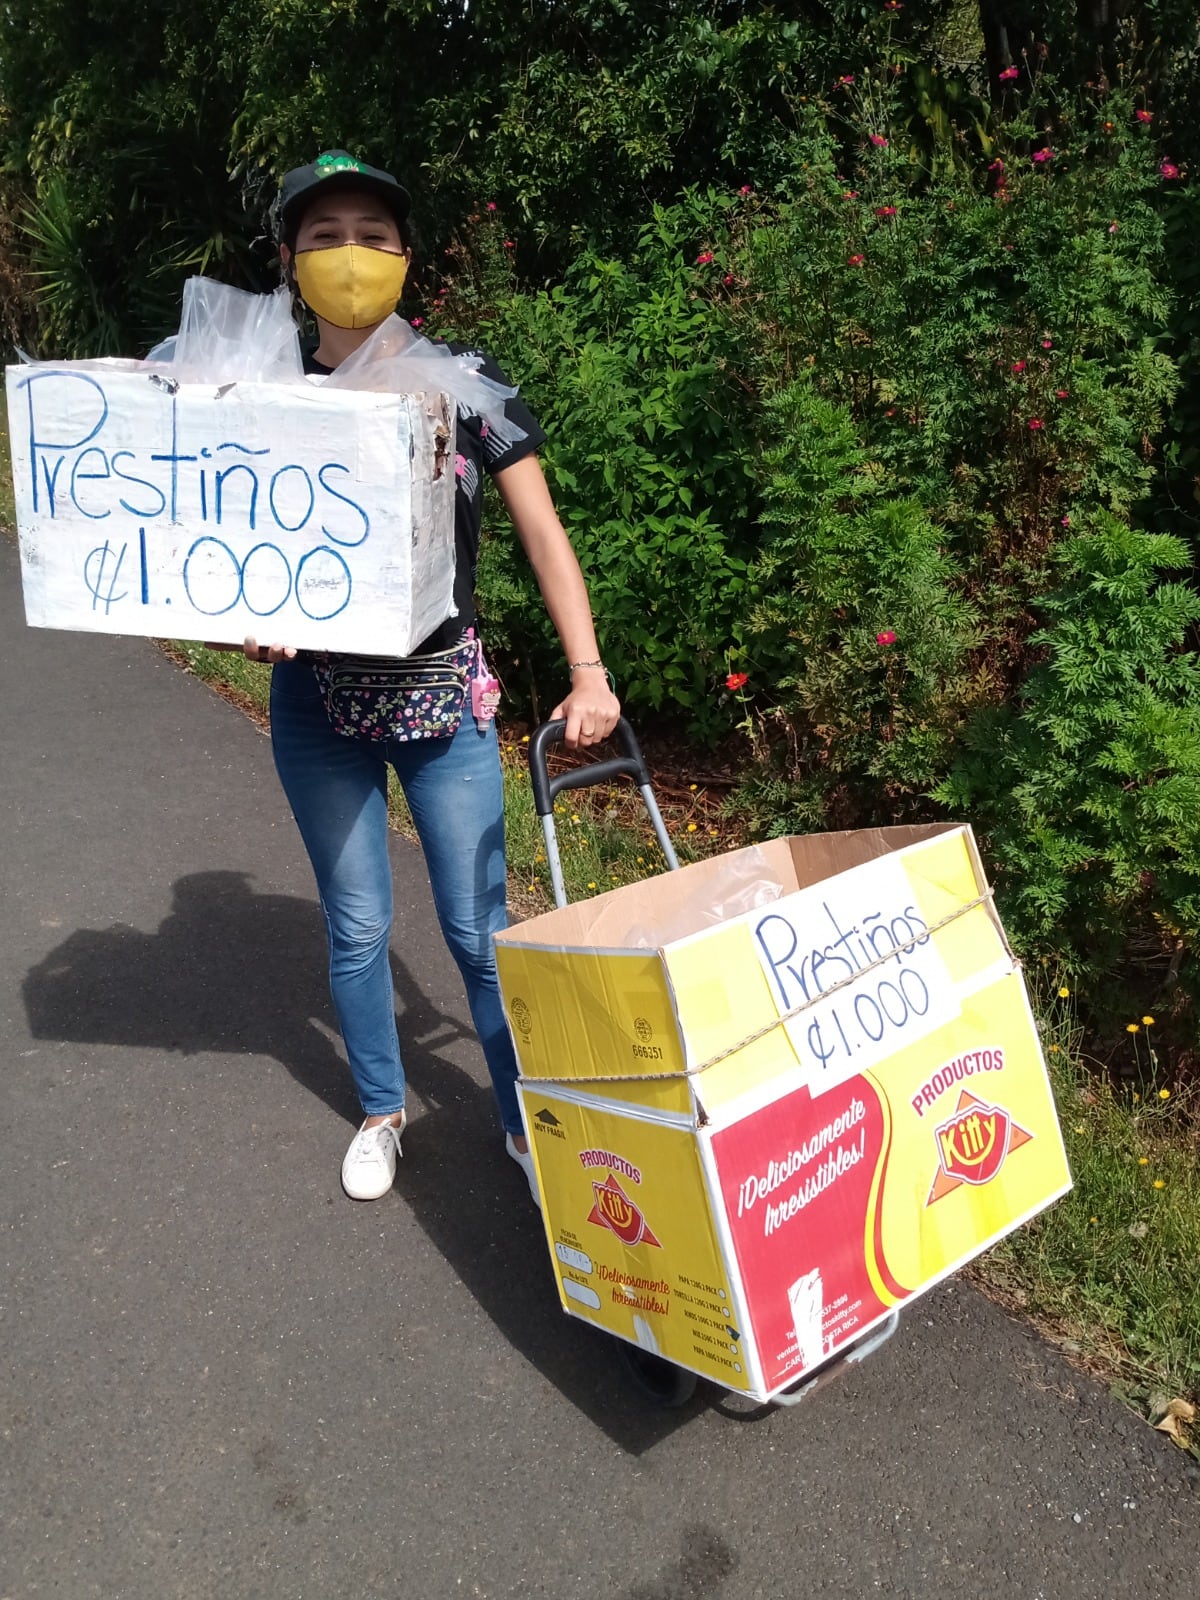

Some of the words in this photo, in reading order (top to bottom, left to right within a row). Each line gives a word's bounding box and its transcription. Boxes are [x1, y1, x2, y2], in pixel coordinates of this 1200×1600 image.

[17, 371, 370, 547] Prestiños
[632, 1044, 663, 1060] 666351
[911, 1049, 1003, 1117] PRODUCTOS
[738, 1097, 866, 1218] ¡Deliciosamente
[940, 1112, 996, 1169] Kitty
[579, 1150, 641, 1184] PRODUCTOS
[764, 1127, 865, 1237] Irresistibles!
[595, 1188, 633, 1228] Kitty
[611, 1287, 669, 1316] Irresistibles!
[842, 1315, 859, 1331] RICA
